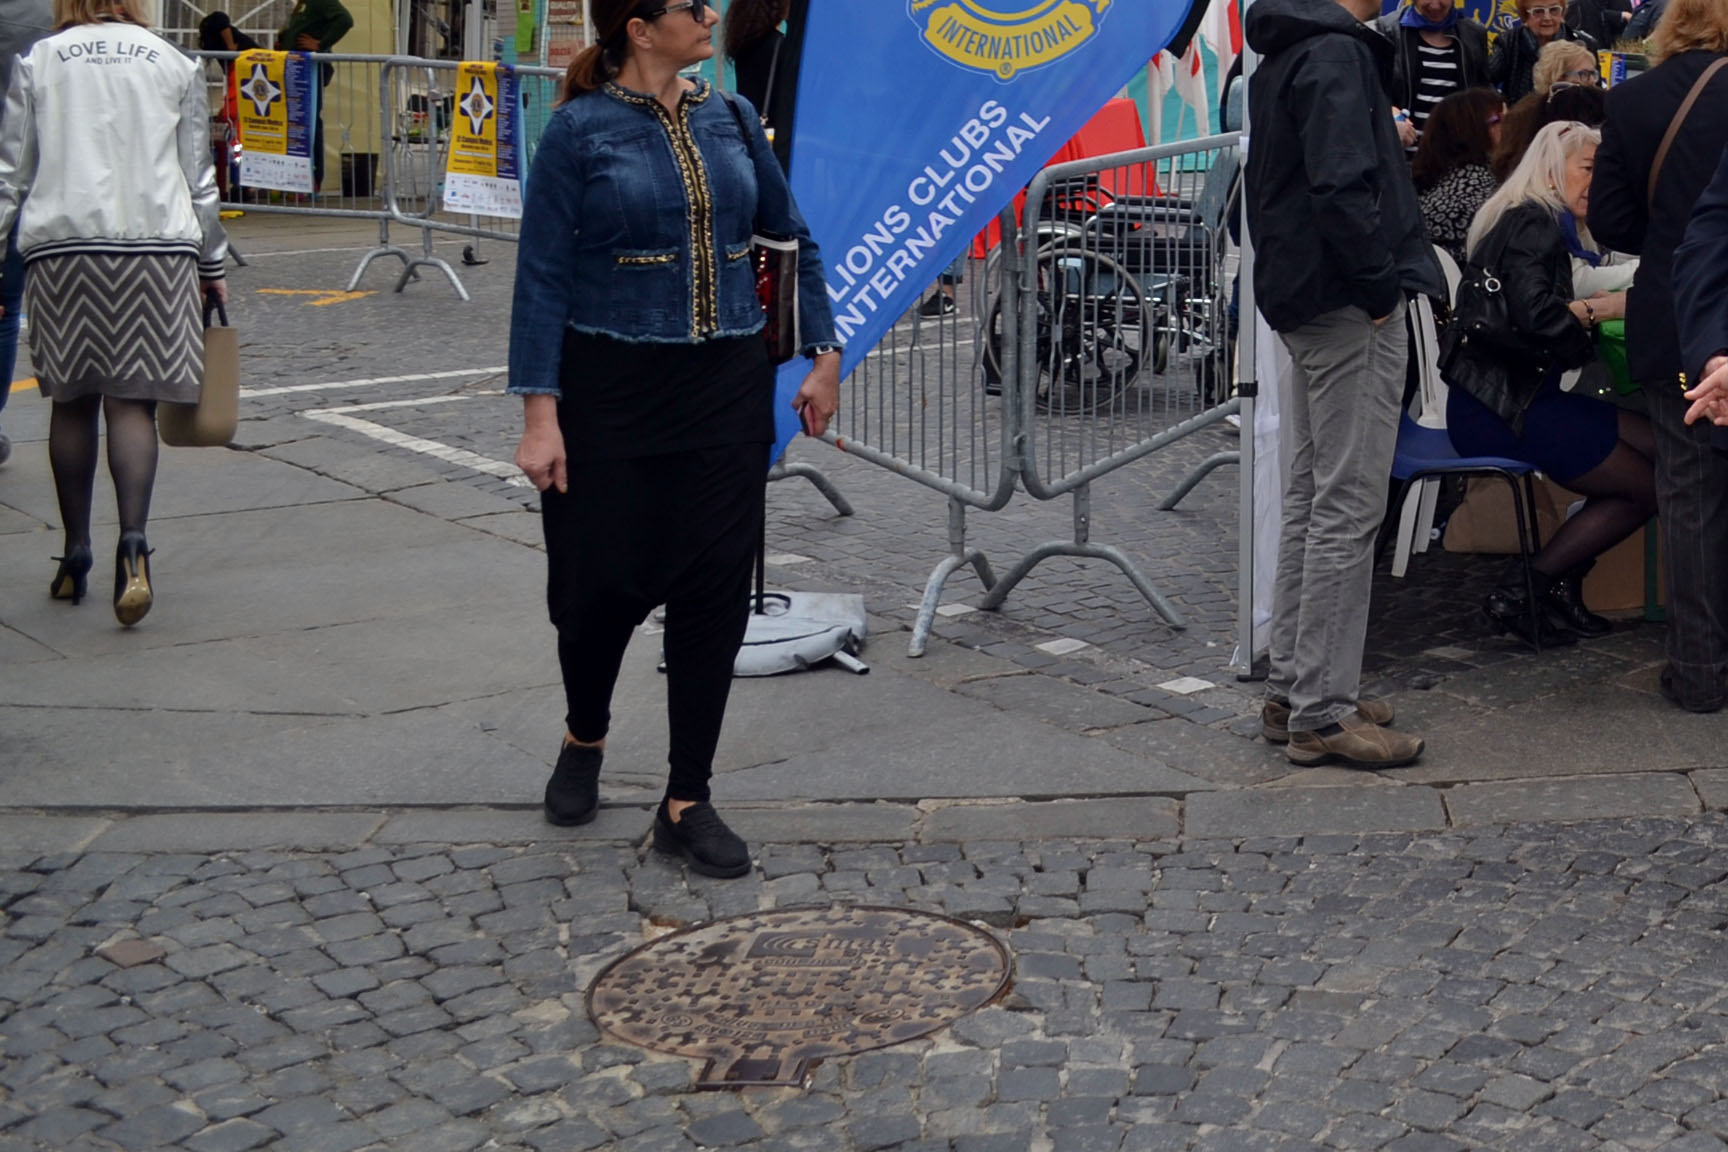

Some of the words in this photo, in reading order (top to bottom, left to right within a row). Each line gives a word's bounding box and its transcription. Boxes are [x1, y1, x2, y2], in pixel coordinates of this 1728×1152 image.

[57, 41, 107, 62] LOVE
[117, 42, 160, 63] LIFE
[936, 14, 1082, 60] INTERNATIONAL
[826, 205, 911, 303] LIONS
[908, 100, 1007, 205] CLUBS
[835, 112, 1051, 344] INTERNATIONAL
